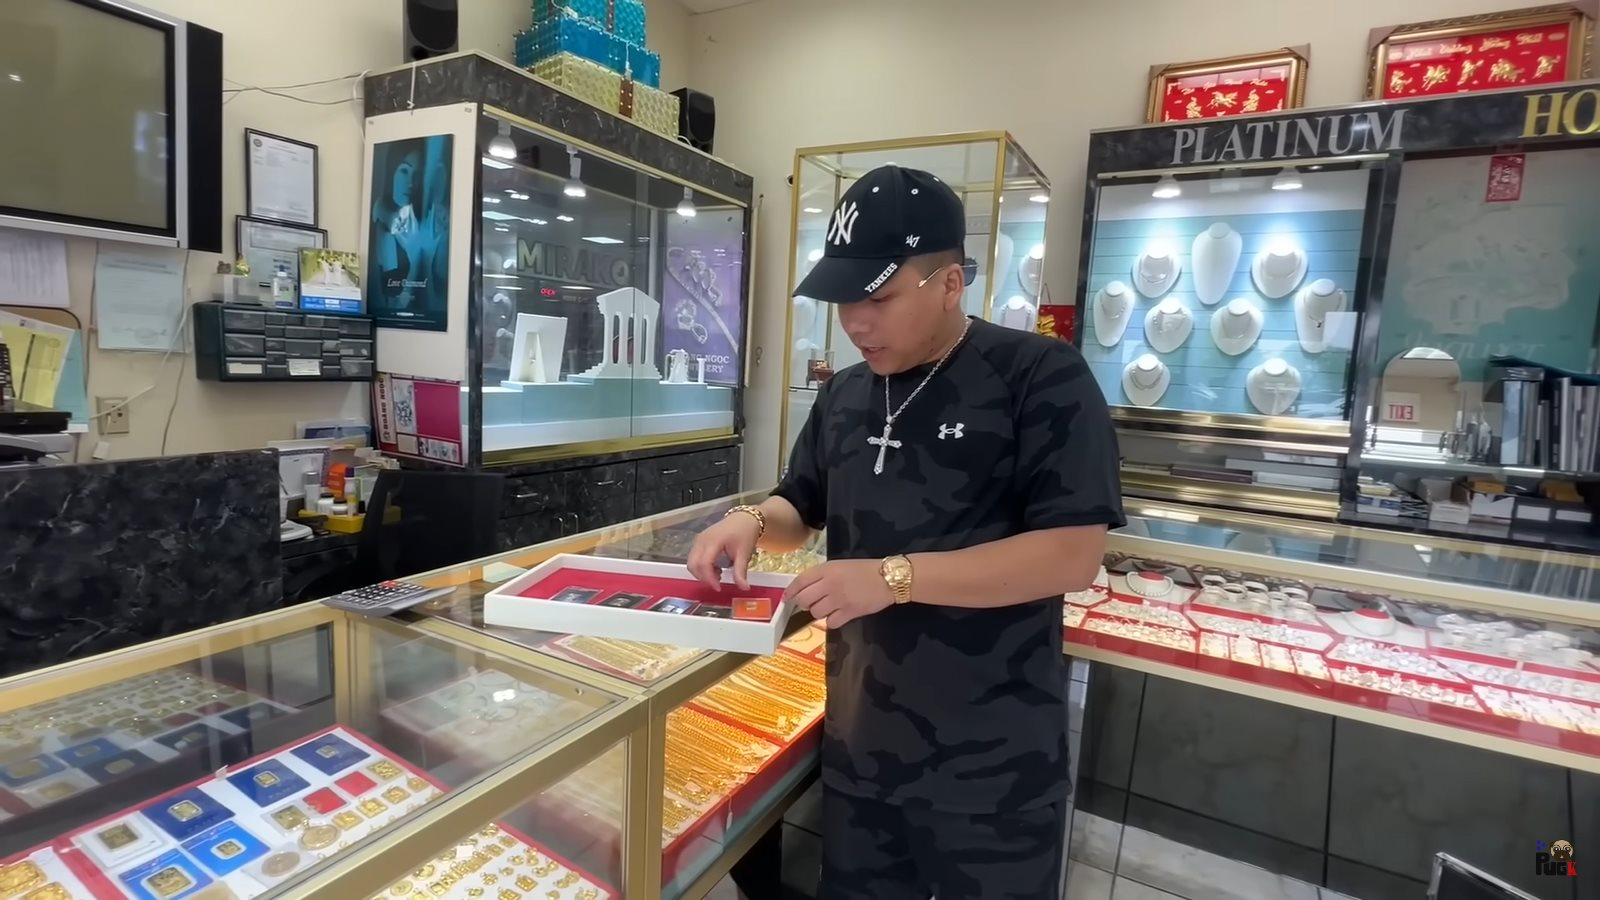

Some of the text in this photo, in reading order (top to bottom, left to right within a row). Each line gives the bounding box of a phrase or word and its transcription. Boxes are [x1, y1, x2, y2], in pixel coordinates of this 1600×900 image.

[1170, 108, 1409, 165] PLATINUM
[1517, 88, 1600, 139] HO
[864, 262, 898, 293] YANKEES
